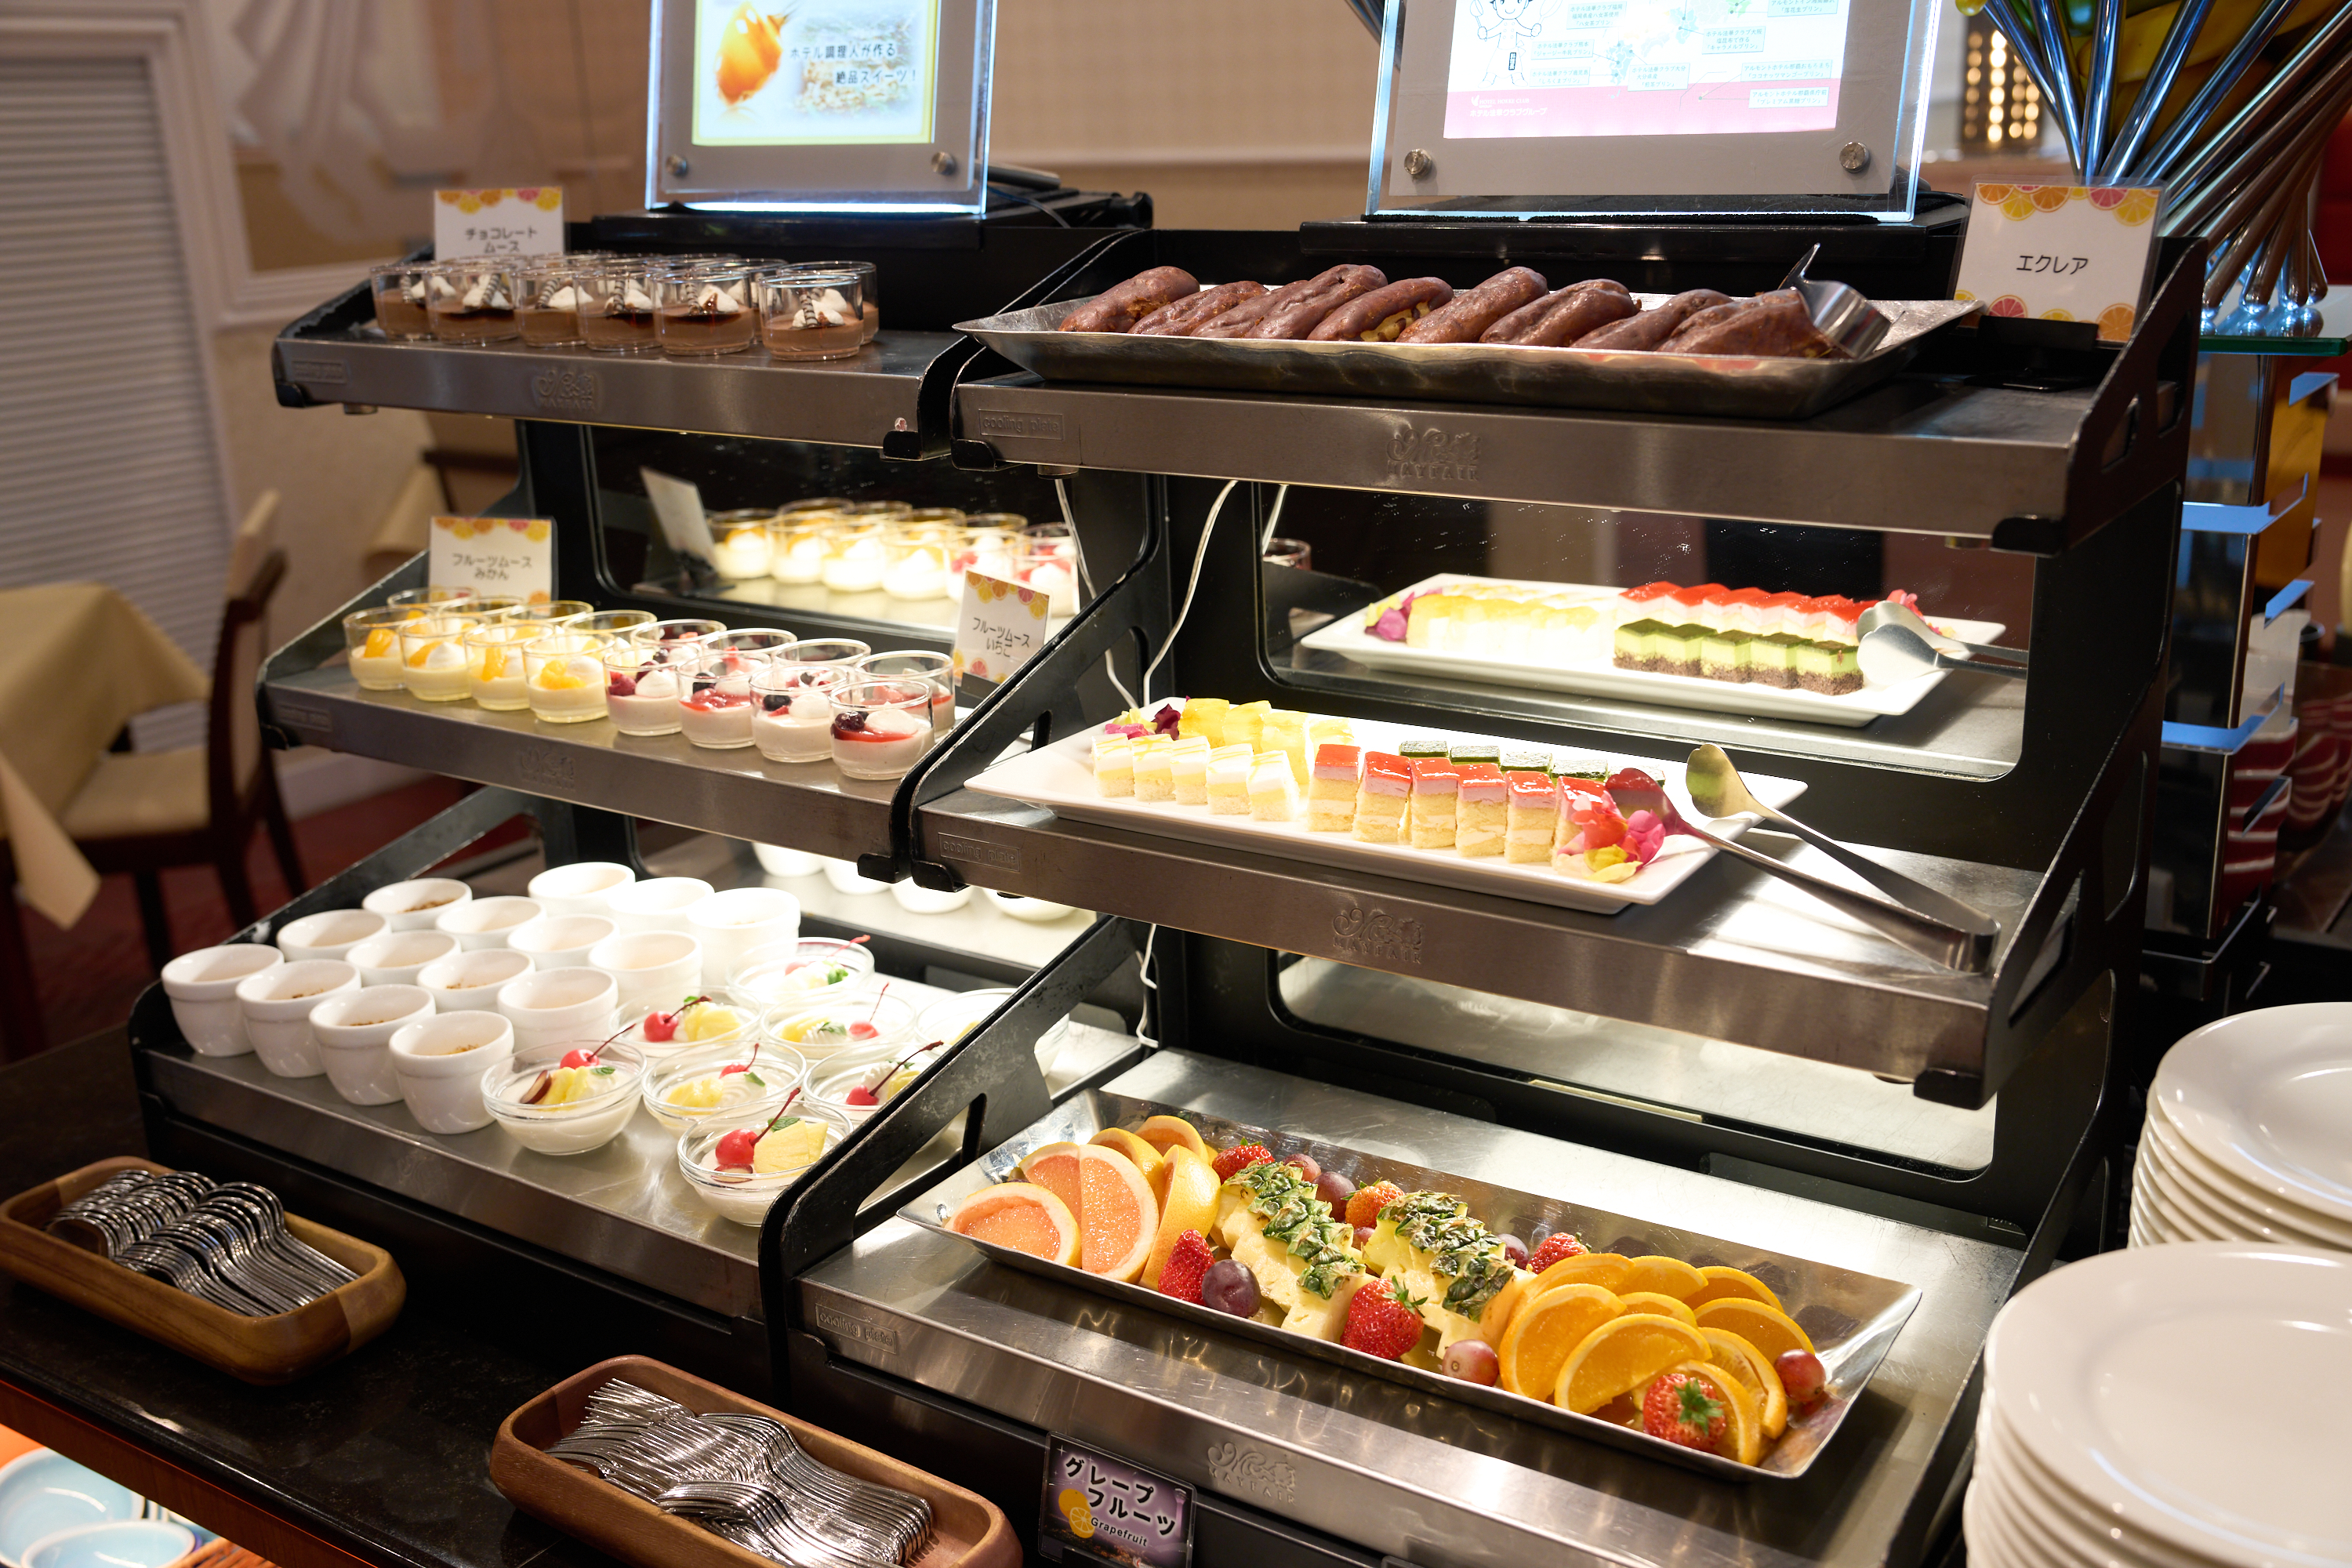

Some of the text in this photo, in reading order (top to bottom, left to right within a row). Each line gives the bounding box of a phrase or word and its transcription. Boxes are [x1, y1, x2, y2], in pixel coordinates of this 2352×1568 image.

[790, 43, 895, 60] ホテル調理人が作る
[1470, 107, 1548, 118] ホテル法華クラブグループ
[465, 225, 537, 241] チョコレート
[484, 240, 520, 254] ムース
[2016, 254, 2089, 275] エクレア
[452, 552, 532, 569] フルーツムース
[474, 568, 510, 581] みかん
[972, 617, 1030, 648] フルーツムース
[943, 840, 1016, 863] cooling plate
[819, 1312, 893, 1346] cooling plate
[1065, 1456, 1155, 1504] グレープ
[1207, 1465, 1295, 1505] MAYFAIR
[1087, 1487, 1176, 1537] フルーツ
[1091, 1516, 1149, 1548] Grapefruit
